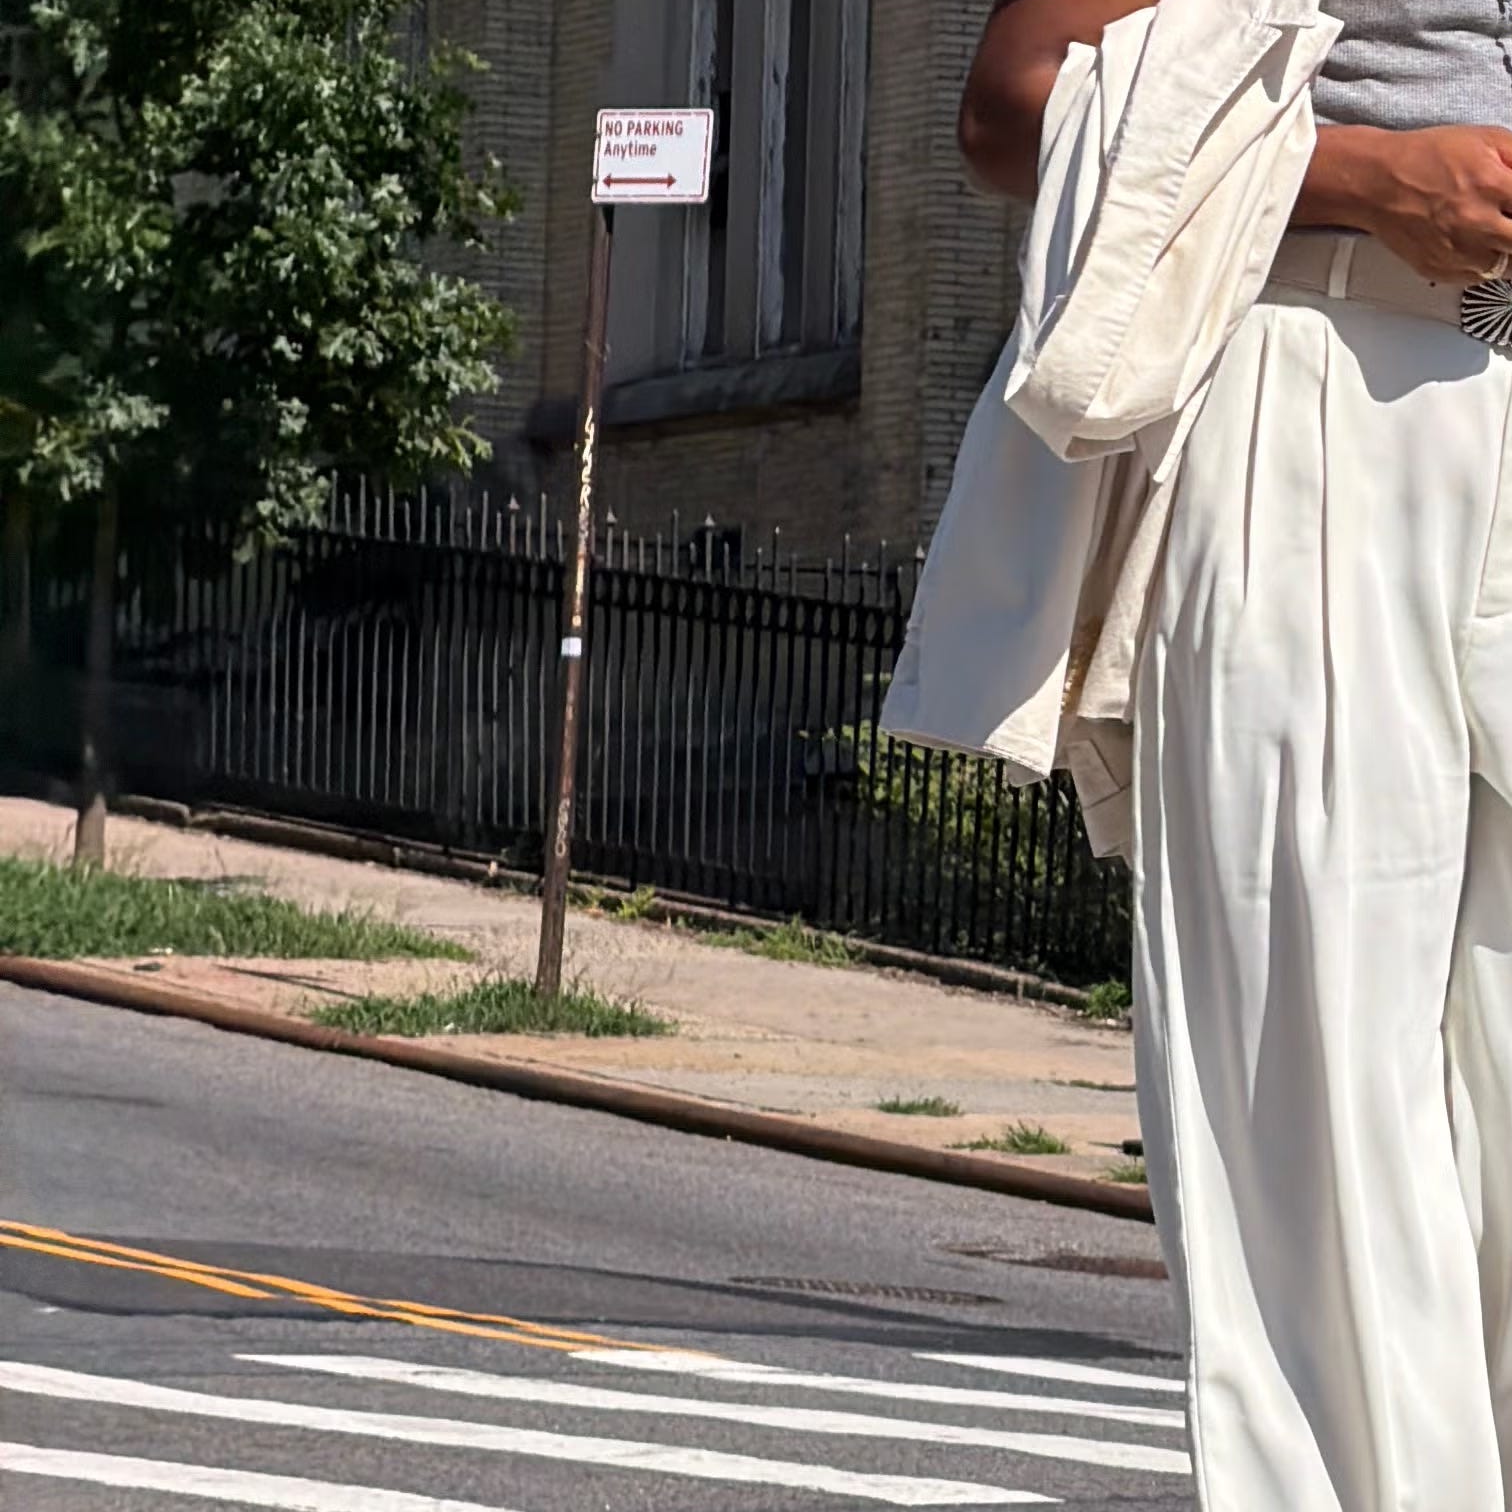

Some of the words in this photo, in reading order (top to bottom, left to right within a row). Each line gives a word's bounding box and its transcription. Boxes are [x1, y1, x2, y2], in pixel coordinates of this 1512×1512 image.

[604, 119, 623, 136] NO
[626, 119, 684, 136] PARKING
[603, 140, 657, 160] Anytime
